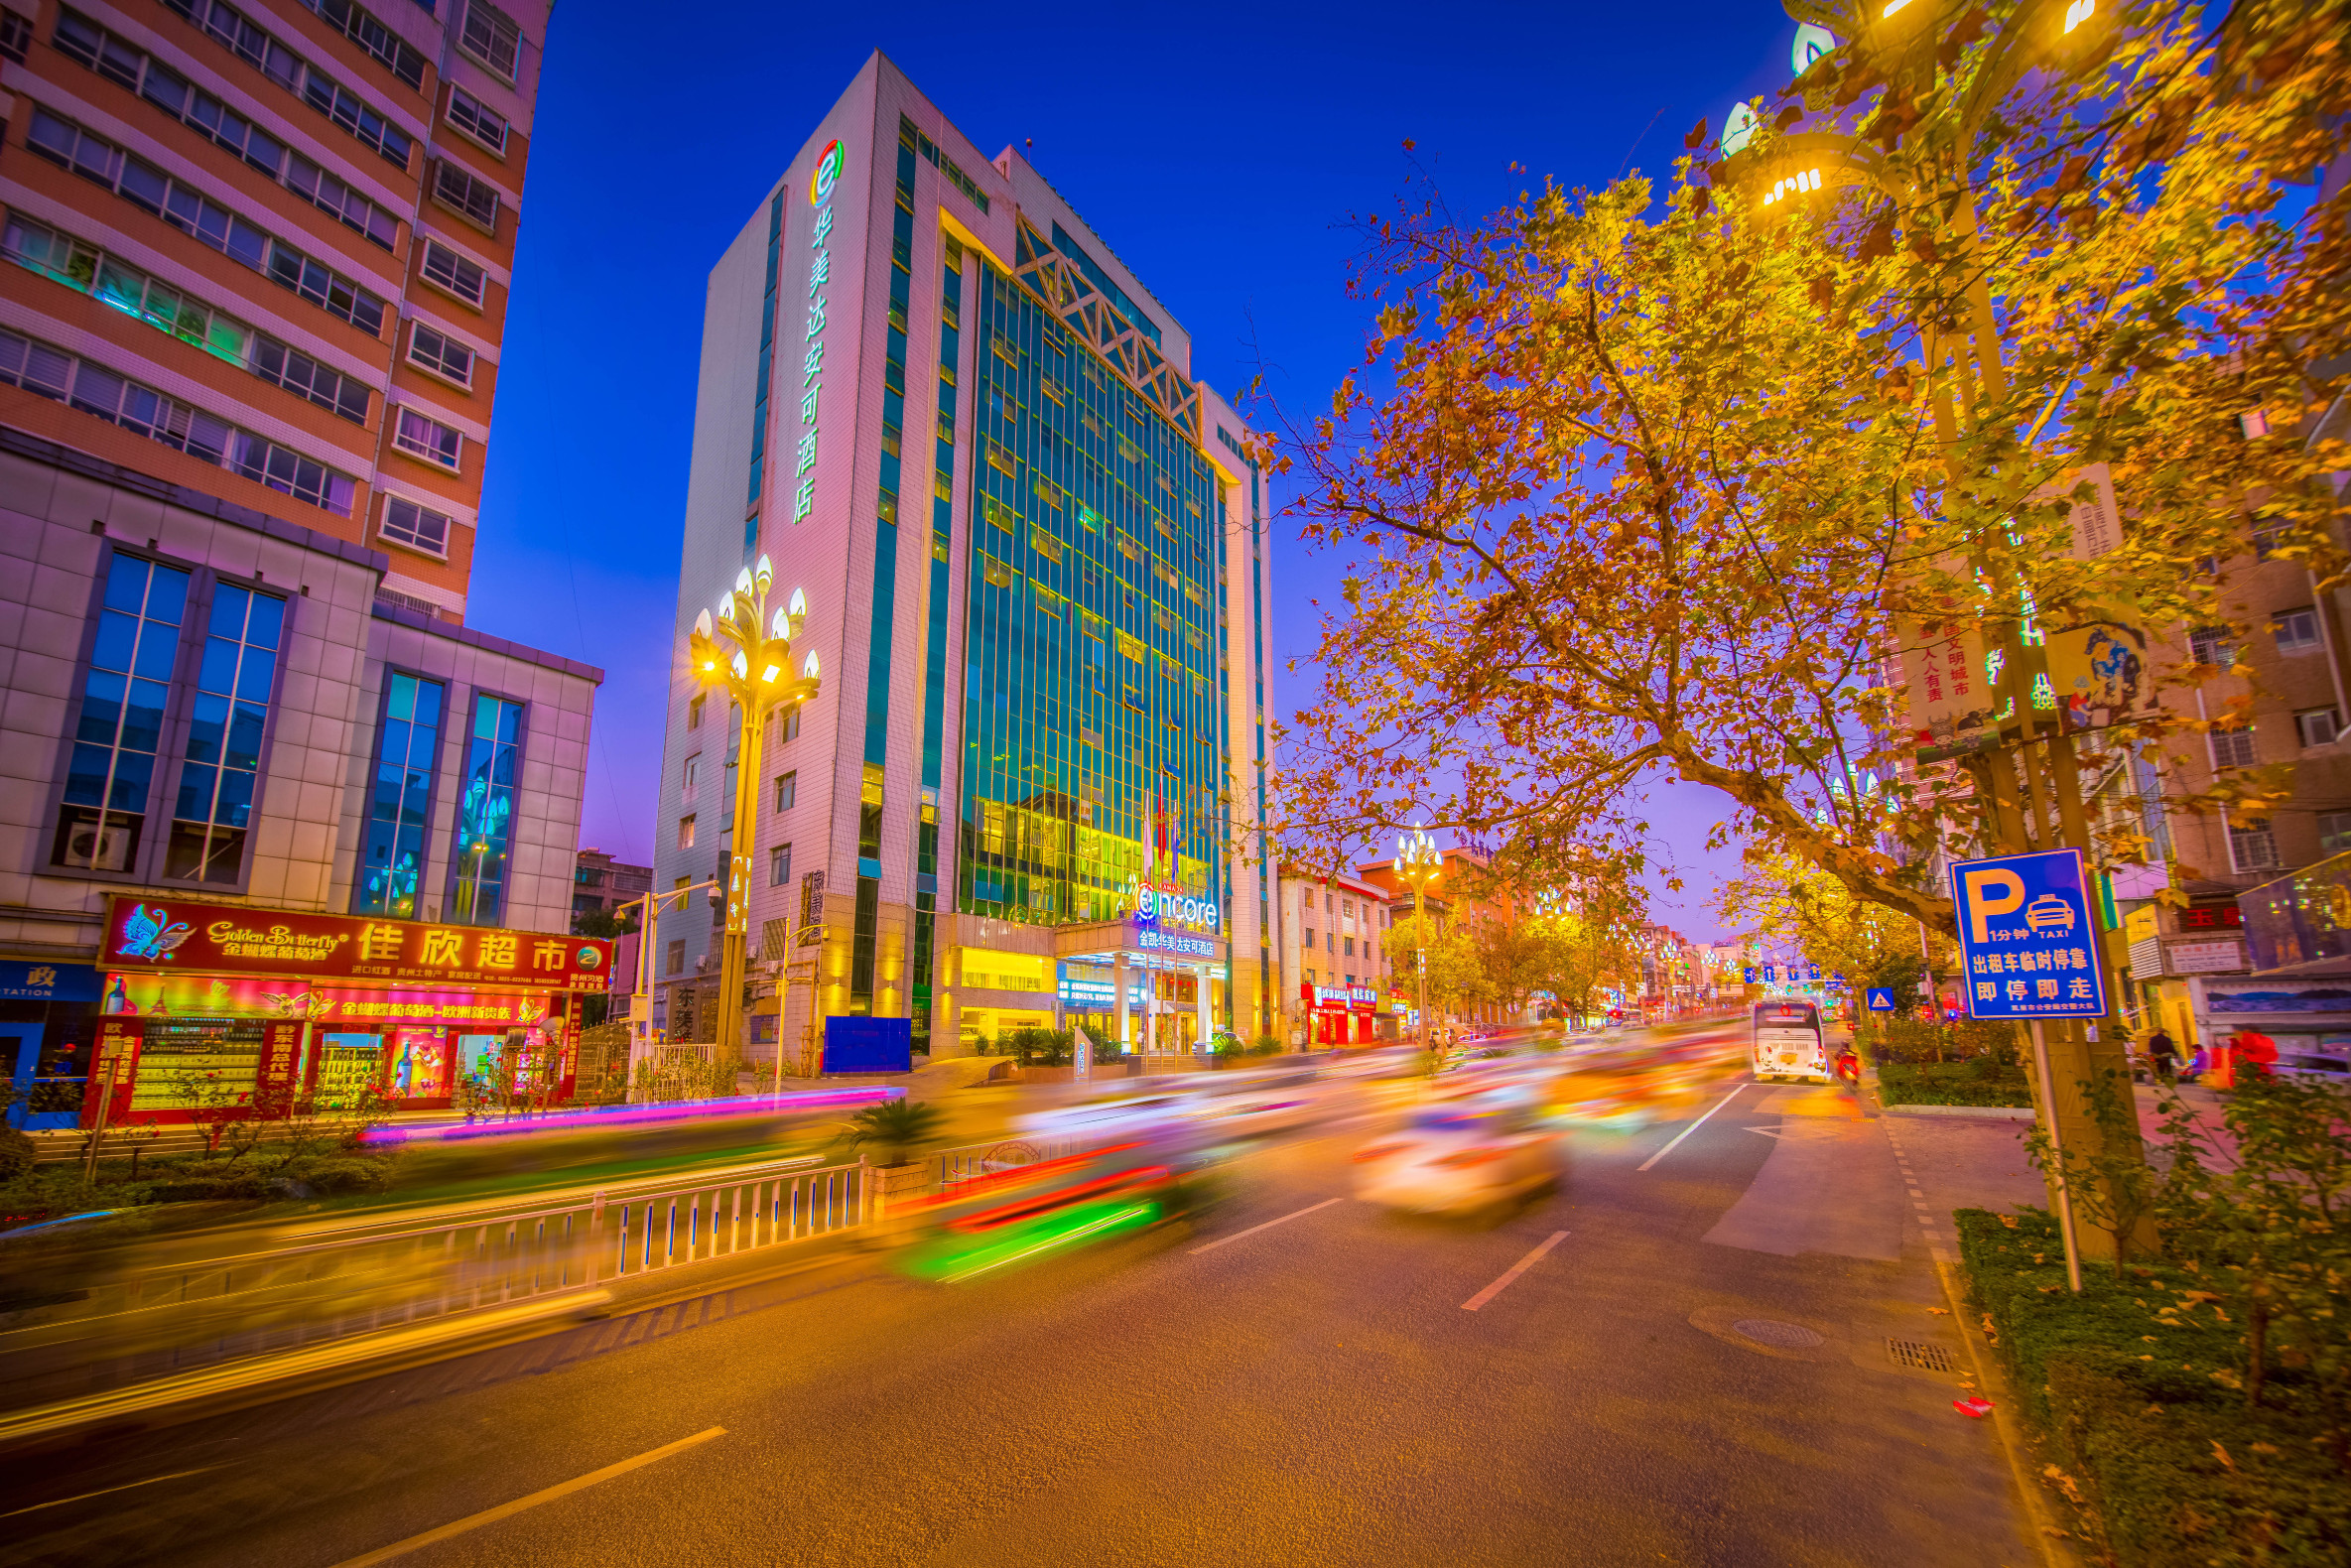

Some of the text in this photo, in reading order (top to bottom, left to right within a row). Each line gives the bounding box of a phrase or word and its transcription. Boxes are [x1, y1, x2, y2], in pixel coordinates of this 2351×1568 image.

[794, 205, 833, 524] 华美达安可酒店
[1942, 597, 1970, 696] 国文明城市
[1139, 887, 1217, 926] encore
[1965, 868, 2025, 943] P
[206, 921, 264, 944] Golden
[1989, 928, 2029, 942] 1分钟
[2039, 930, 2069, 939] TAXI
[222, 943, 328, 961] 金蝴蝶葡萄酒
[358, 923, 568, 972] 佳欣超市
[351, 965, 391, 976] 进口红酒
[397, 968, 442, 978] 贵州土特产
[448, 971, 481, 980] 宴席配送
[1973, 948, 2088, 974] 出租车临时停靠
[26, 967, 57, 986] 政
[570, 973, 604, 983] 贵州习酒
[0, 987, 53, 996] TATION
[1976, 977, 2094, 1001] 即停即走
[269, 1024, 296, 1082] 黔东南总代理
